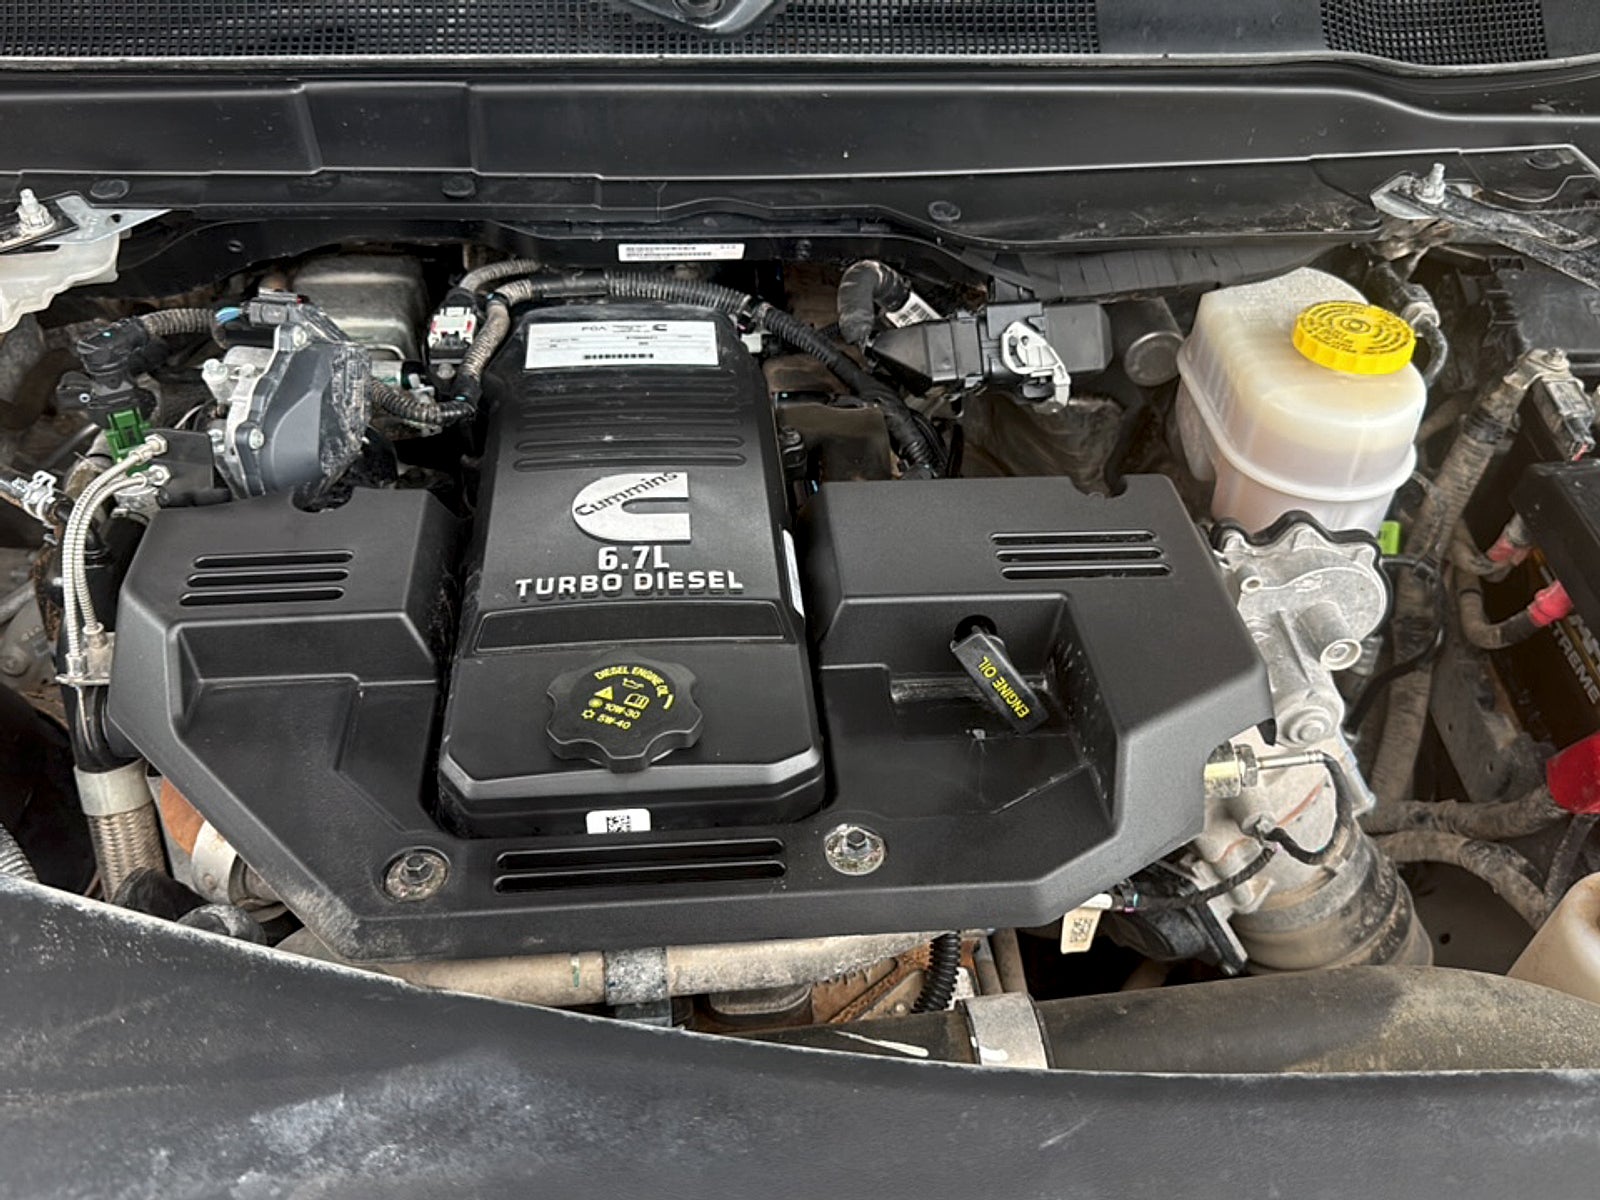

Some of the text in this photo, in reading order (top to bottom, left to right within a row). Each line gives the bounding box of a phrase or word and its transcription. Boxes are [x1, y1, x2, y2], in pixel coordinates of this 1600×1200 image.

[573, 471, 679, 517] Cummins
[597, 545, 670, 571] 6.7L
[515, 569, 744, 598] TURBO DIESEL
[594, 665, 630, 681] DIESEL
[631, 666, 665, 687] ENGINE
[1552, 619, 1600, 705] TREME
[978, 655, 1030, 718] ENGINE OIL
